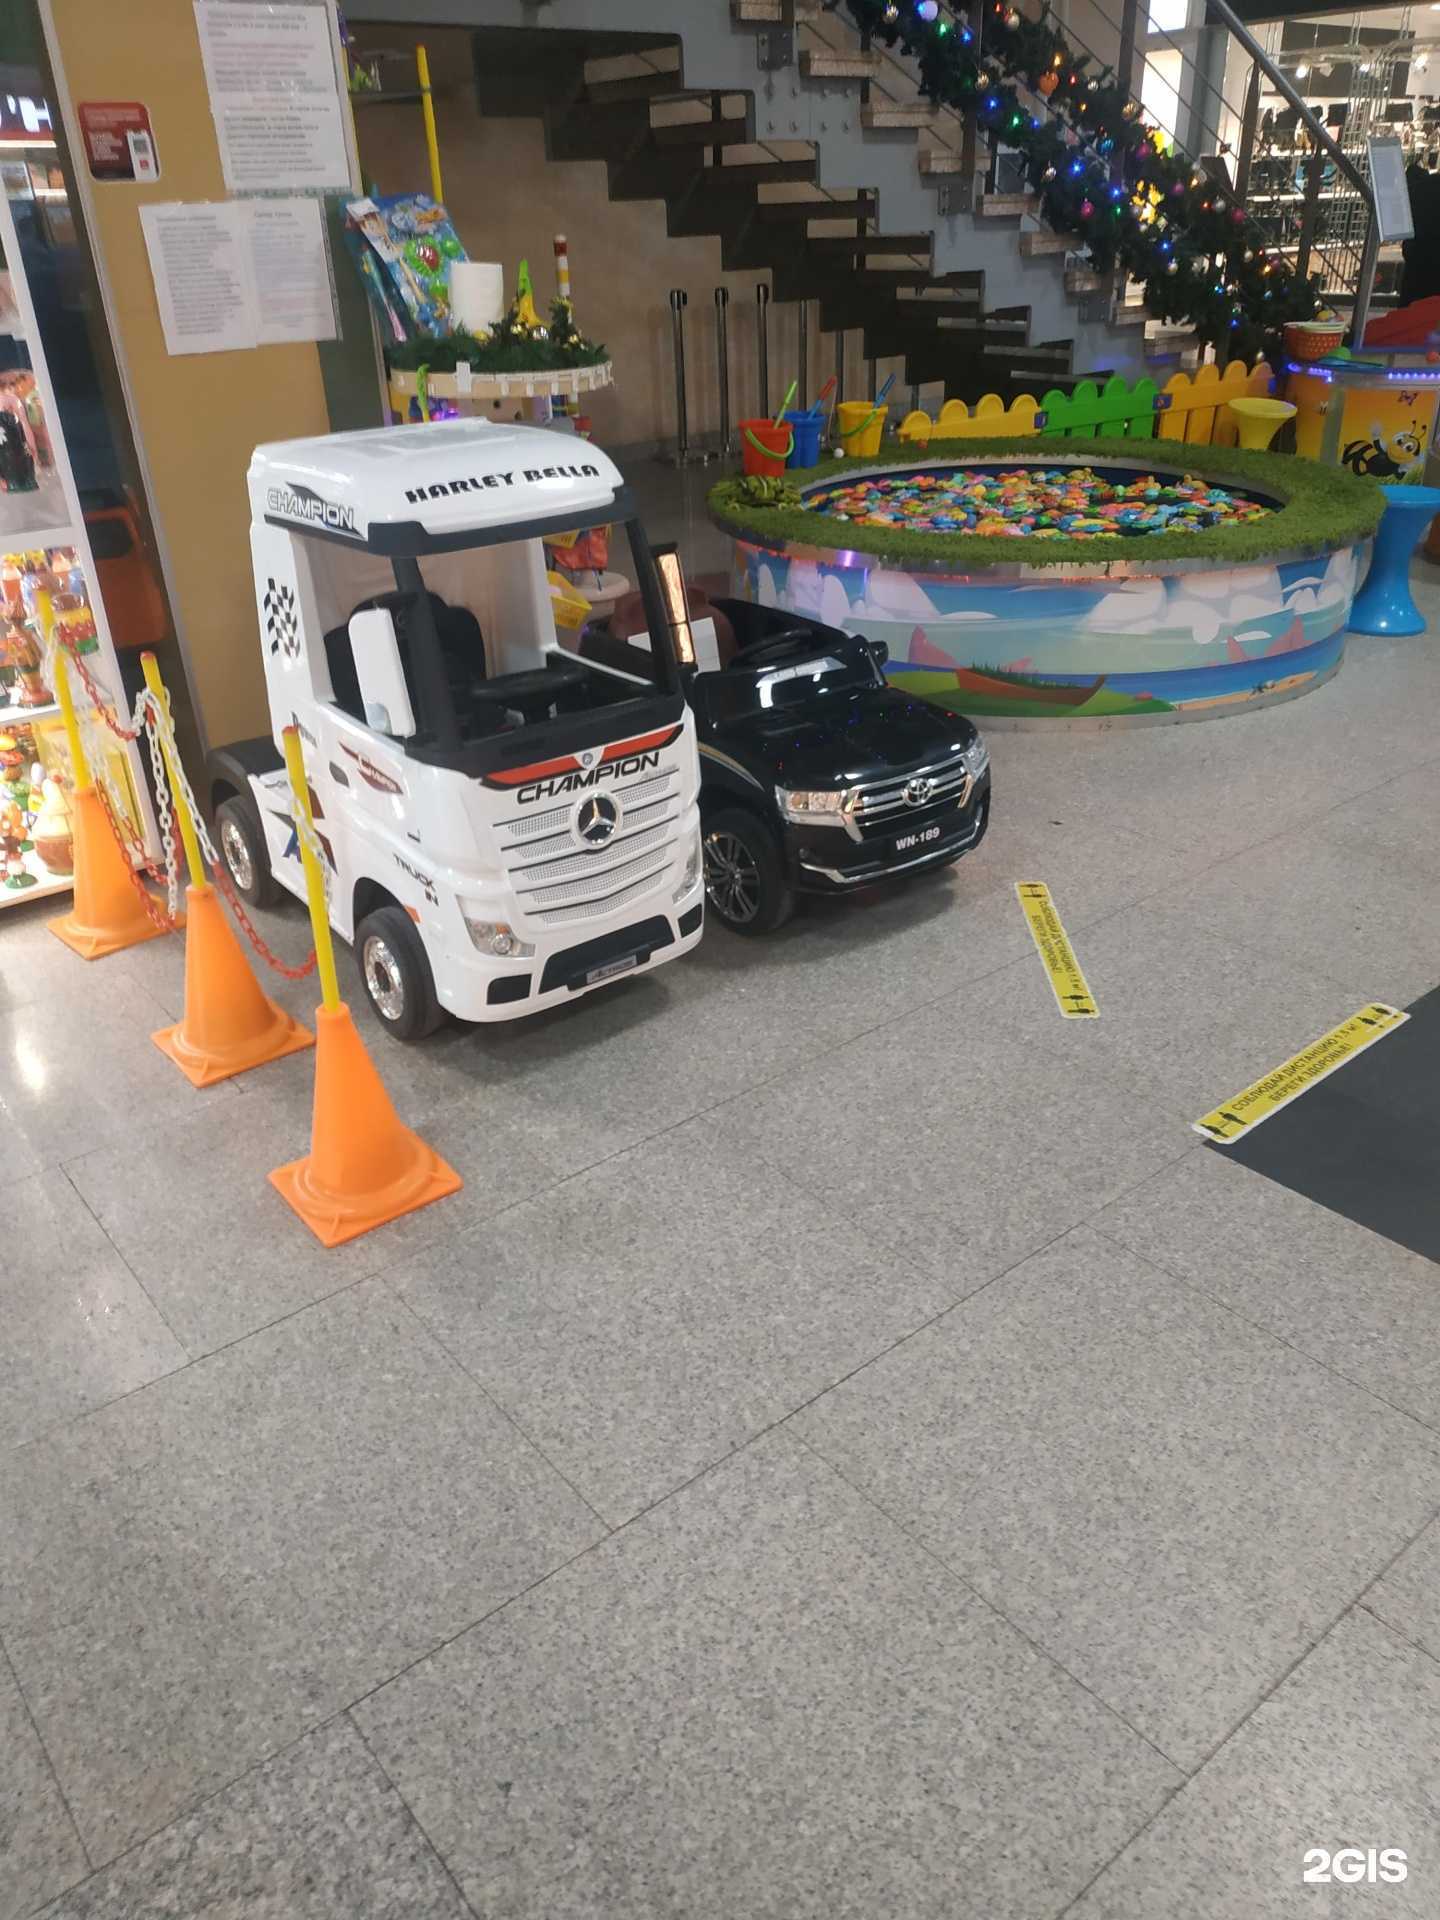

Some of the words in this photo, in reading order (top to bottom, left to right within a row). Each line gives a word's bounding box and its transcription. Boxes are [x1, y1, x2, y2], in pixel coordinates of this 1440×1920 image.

[405, 471, 515, 504] HARLEY
[523, 464, 600, 482] BELLA
[266, 487, 354, 530] CHAMPION
[517, 752, 660, 804] CHAMPION
[896, 827, 940, 850] WN-189
[1231, 1072, 1288, 1111] СОБЛЮДАЙ
[1282, 1037, 1341, 1074] ДИСТАНЦИЮ
[1269, 1075, 1308, 1101] БЕРЕГИ
